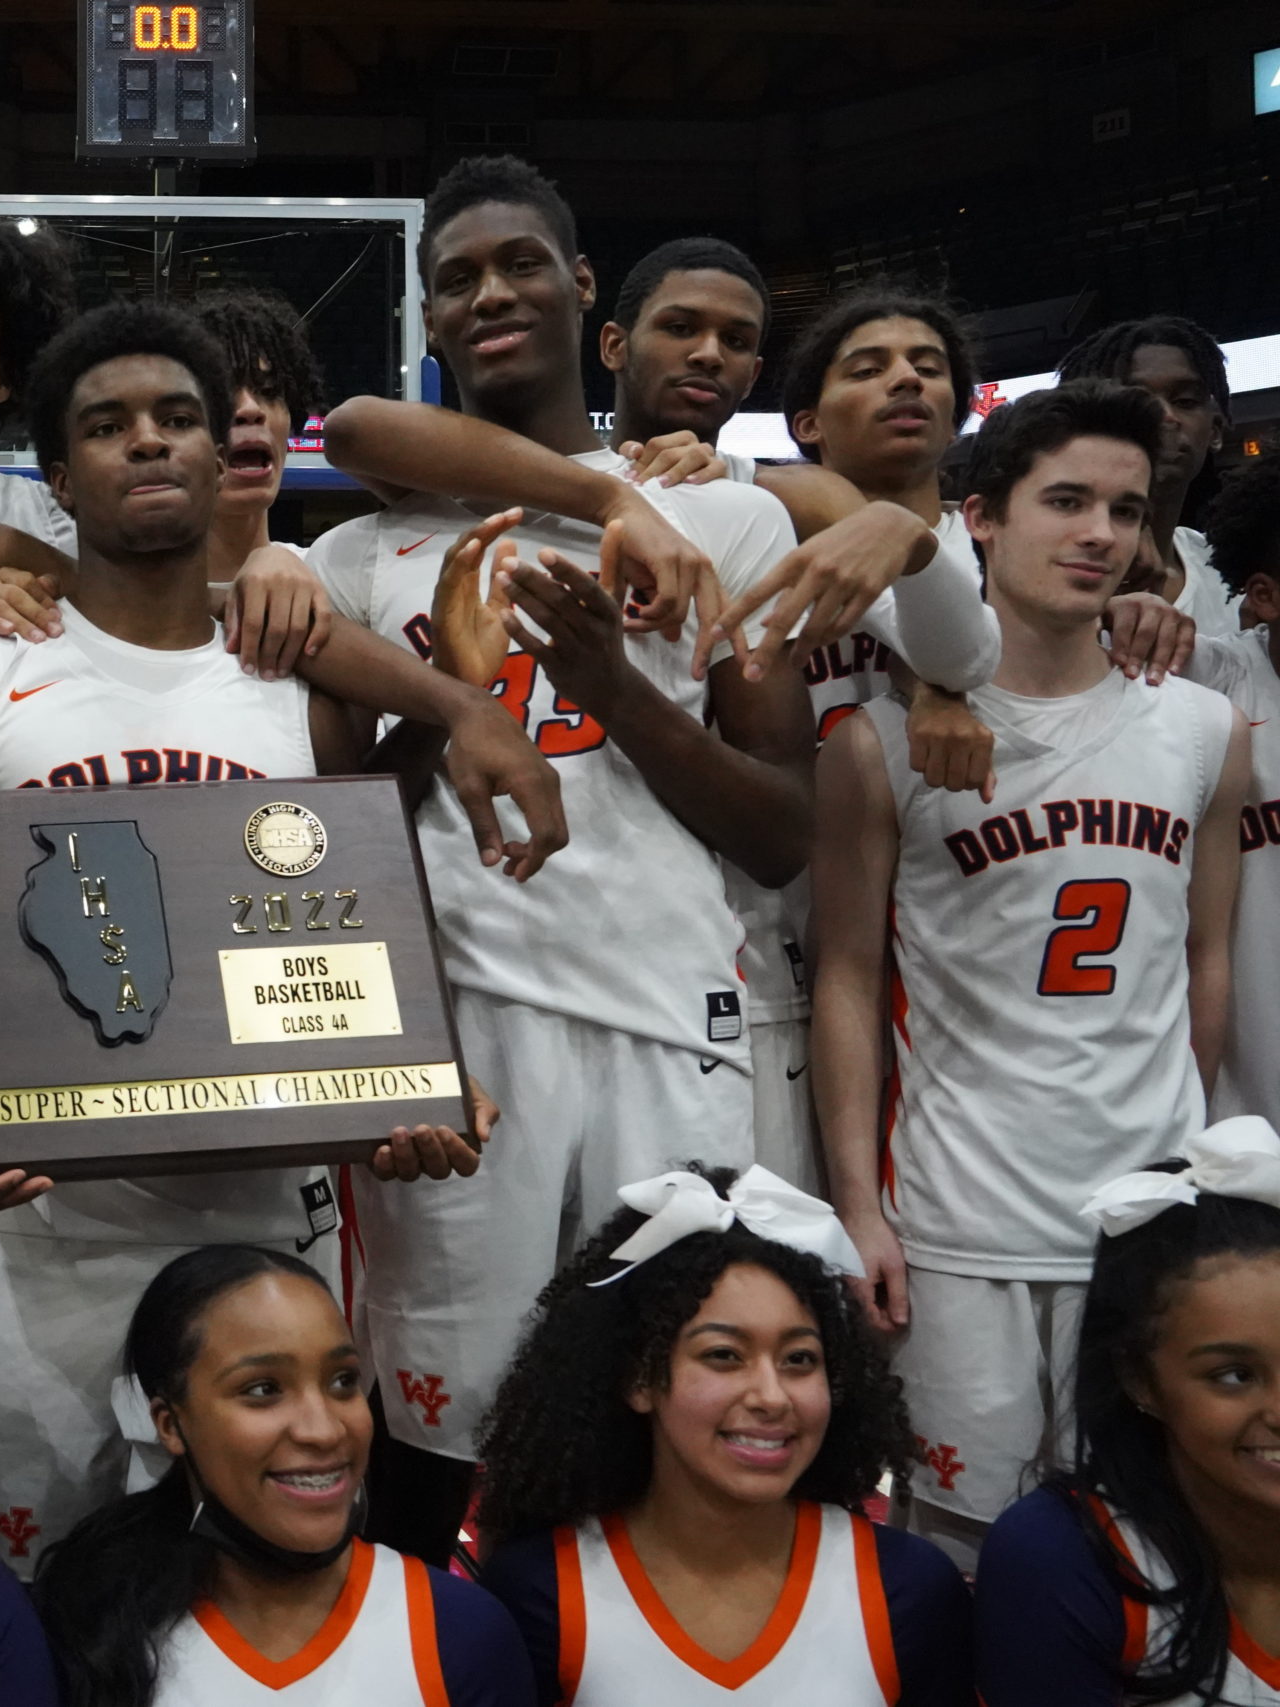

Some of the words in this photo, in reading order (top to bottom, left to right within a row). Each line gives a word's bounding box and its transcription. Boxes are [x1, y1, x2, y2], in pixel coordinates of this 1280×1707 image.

[943, 798, 1190, 878] DOLPHINS
[229, 888, 365, 934] 2022
[1036, 877, 1131, 997] 2
[283, 956, 329, 977] BOYS
[254, 980, 366, 1005] BASKETBALL
[282, 1015, 324, 1034] CLASS
[332, 1013, 349, 1031] 4A
[275, 1067, 433, 1103] CHAMPIONS
